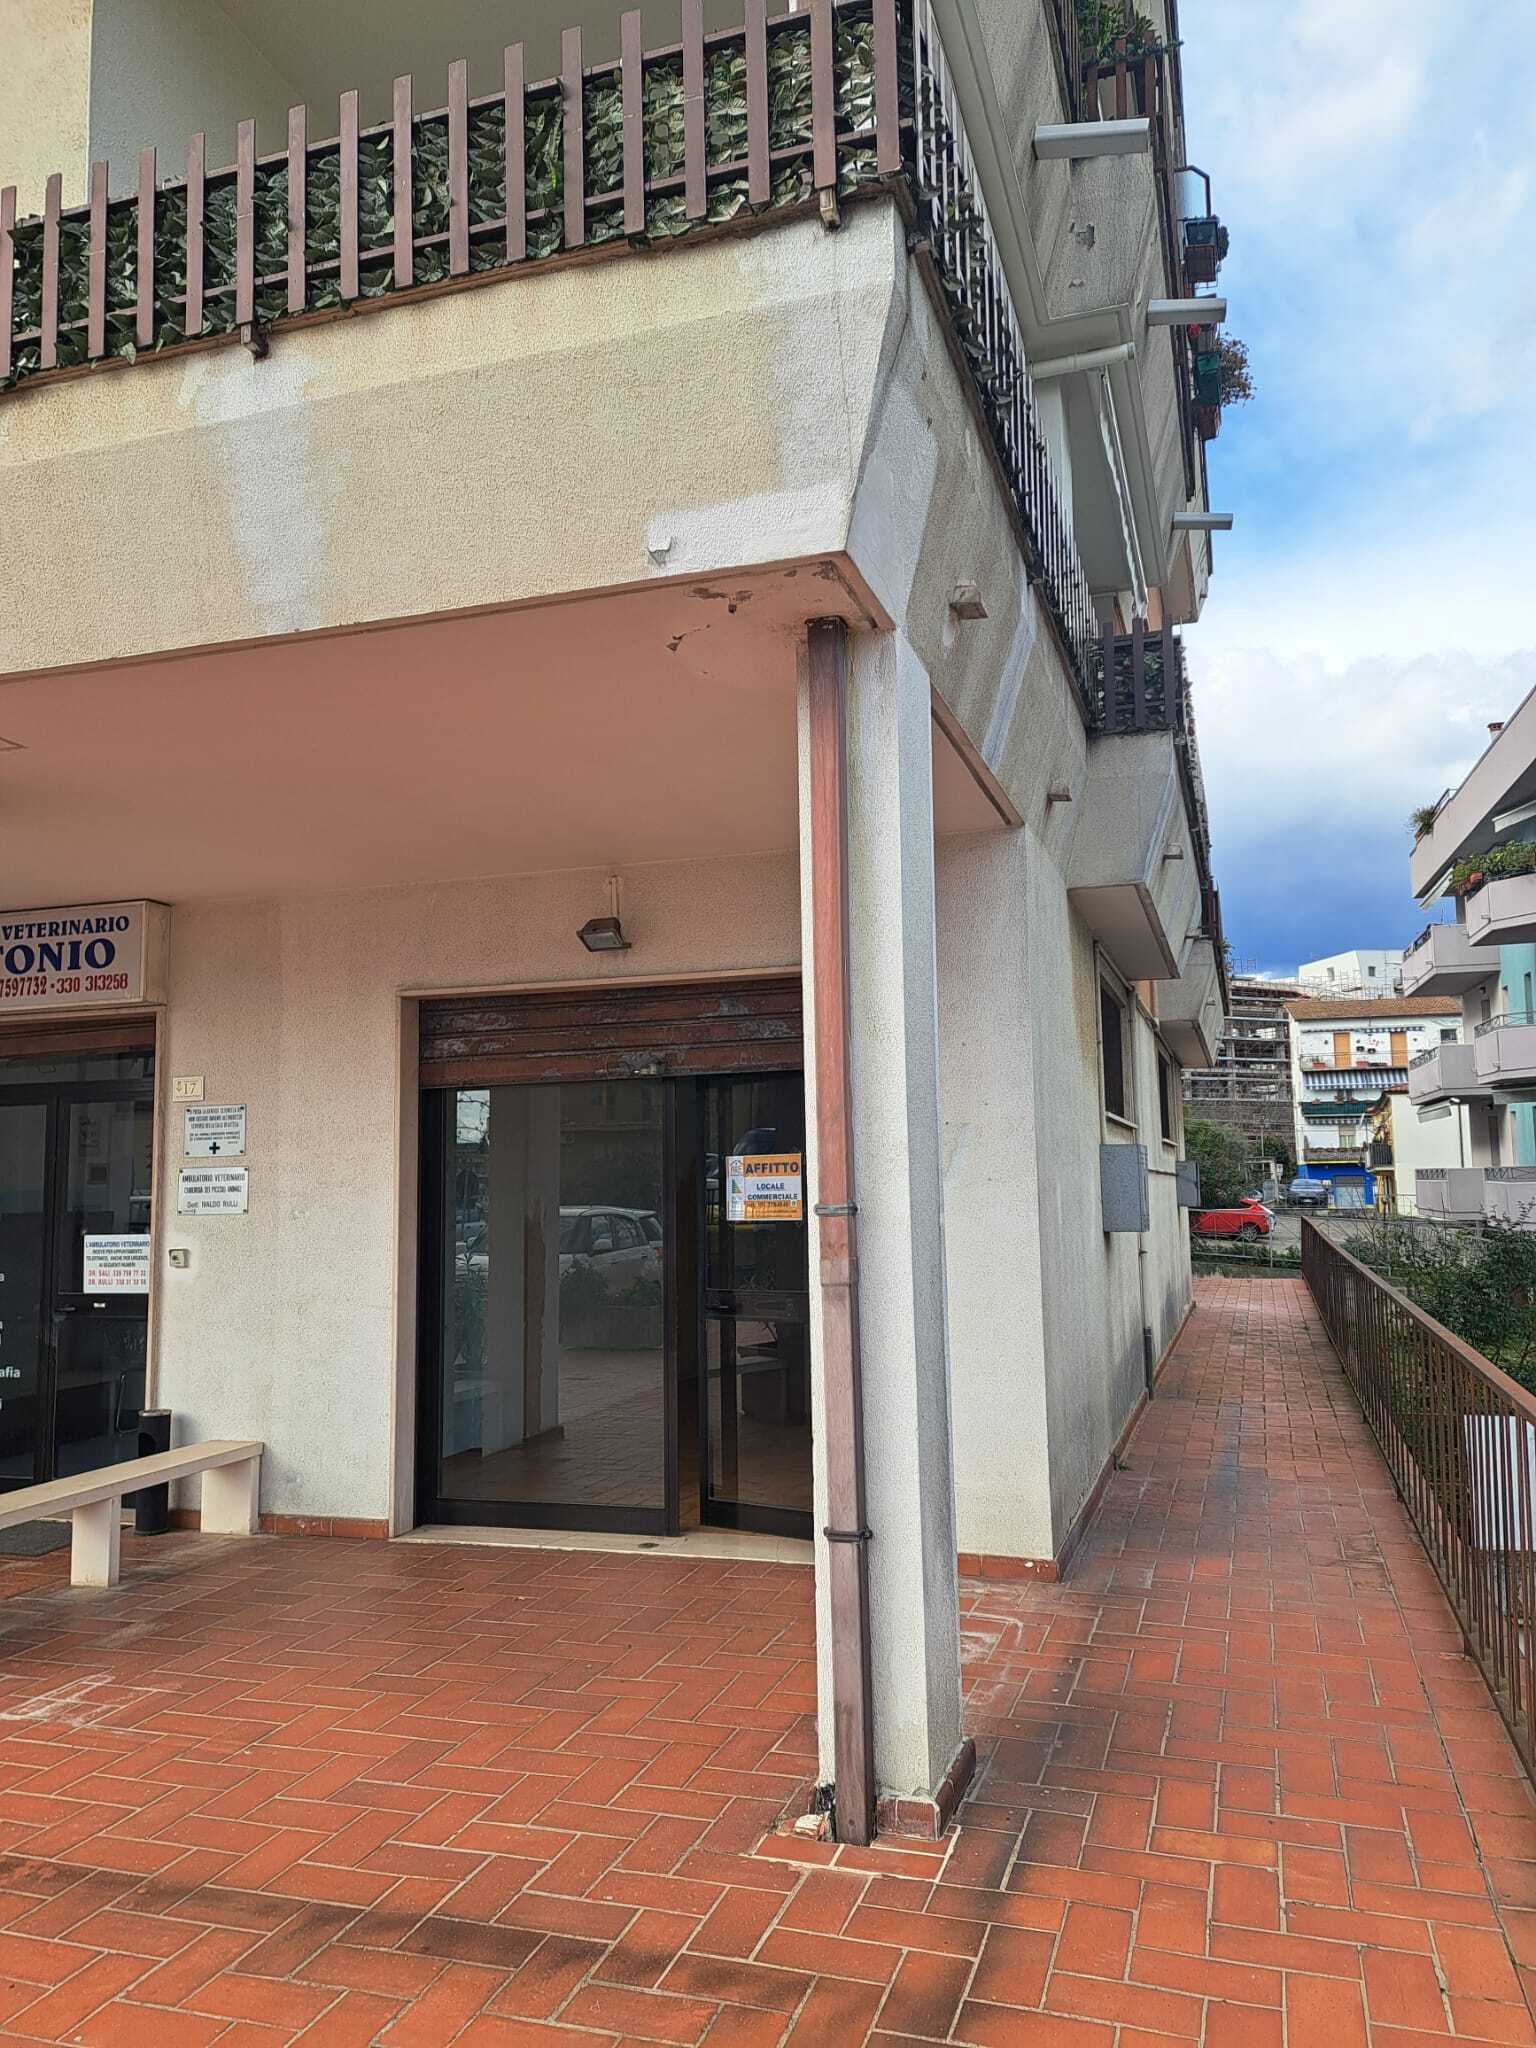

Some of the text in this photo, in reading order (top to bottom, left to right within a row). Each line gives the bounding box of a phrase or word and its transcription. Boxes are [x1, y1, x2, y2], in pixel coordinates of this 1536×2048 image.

[2, 915, 129, 940] VETERINARIO
[0, 938, 116, 975] ONIO
[85, 972, 128, 991] 313258
[184, 1082, 196, 1095] 17
[745, 1161, 799, 1174] AFFITTO
[182, 1173, 245, 1183] AMBULATORIO VETERINARIO
[756, 1182, 785, 1190] LOCALE
